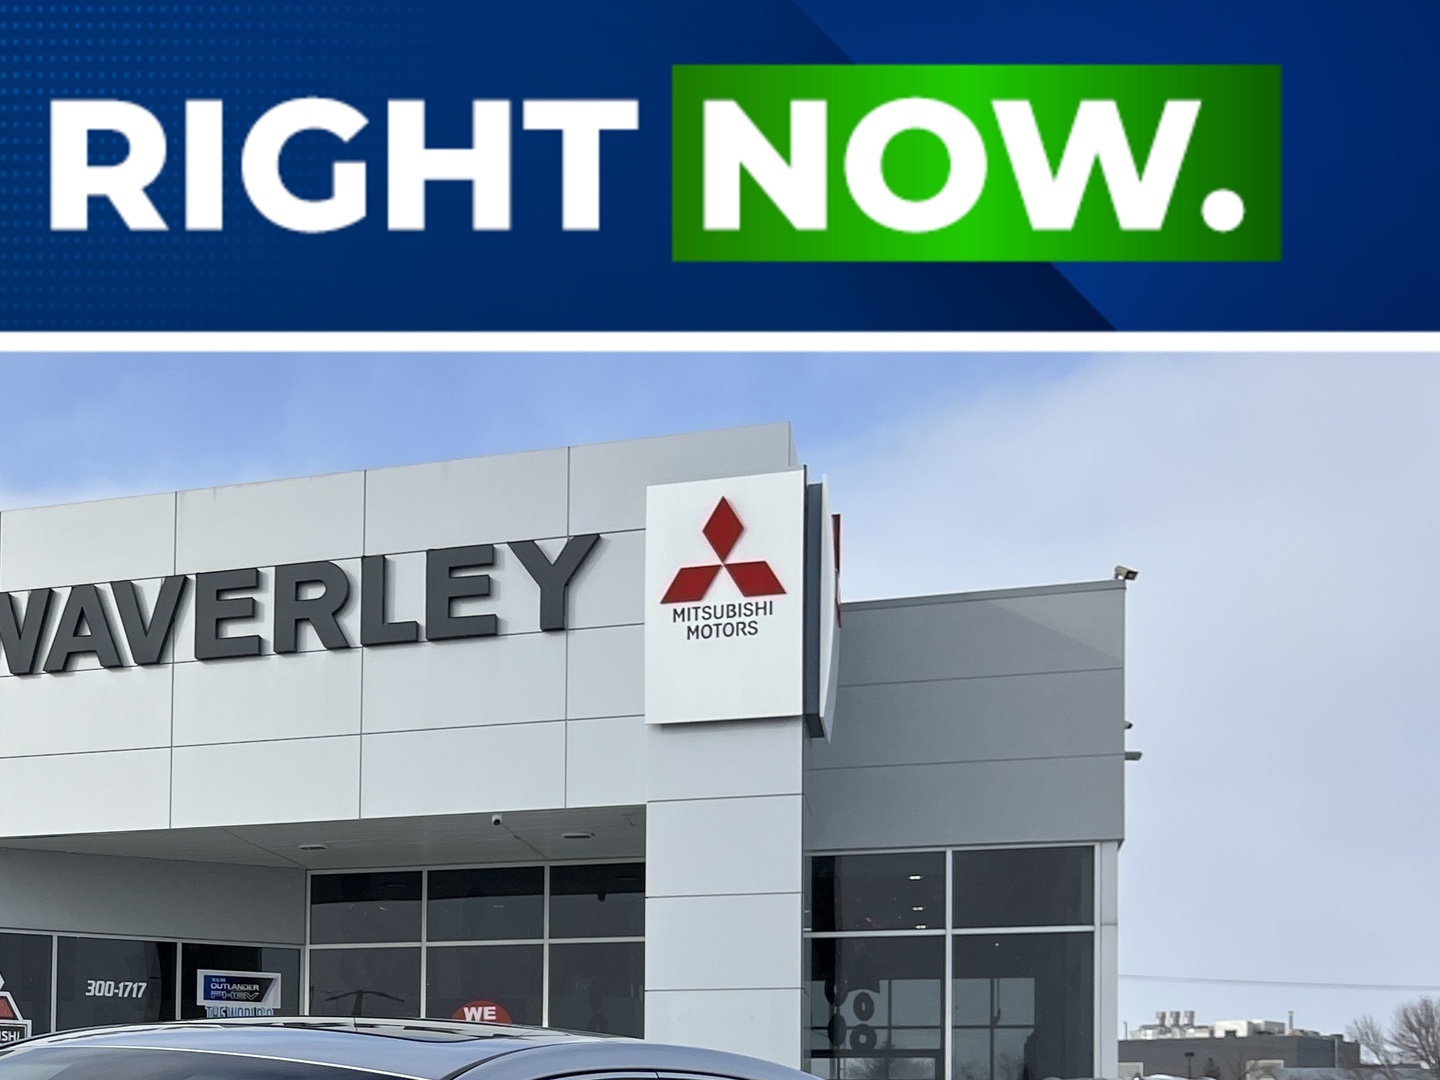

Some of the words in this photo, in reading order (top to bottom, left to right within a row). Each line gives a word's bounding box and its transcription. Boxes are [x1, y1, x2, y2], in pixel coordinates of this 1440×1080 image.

[672, 600, 774, 623] MITSUBISHI
[686, 620, 759, 640] MOTORS
[85, 980, 147, 998] 300-1717
[210, 983, 260, 991] OUTLANDER
[463, 1006, 497, 1021] WE
